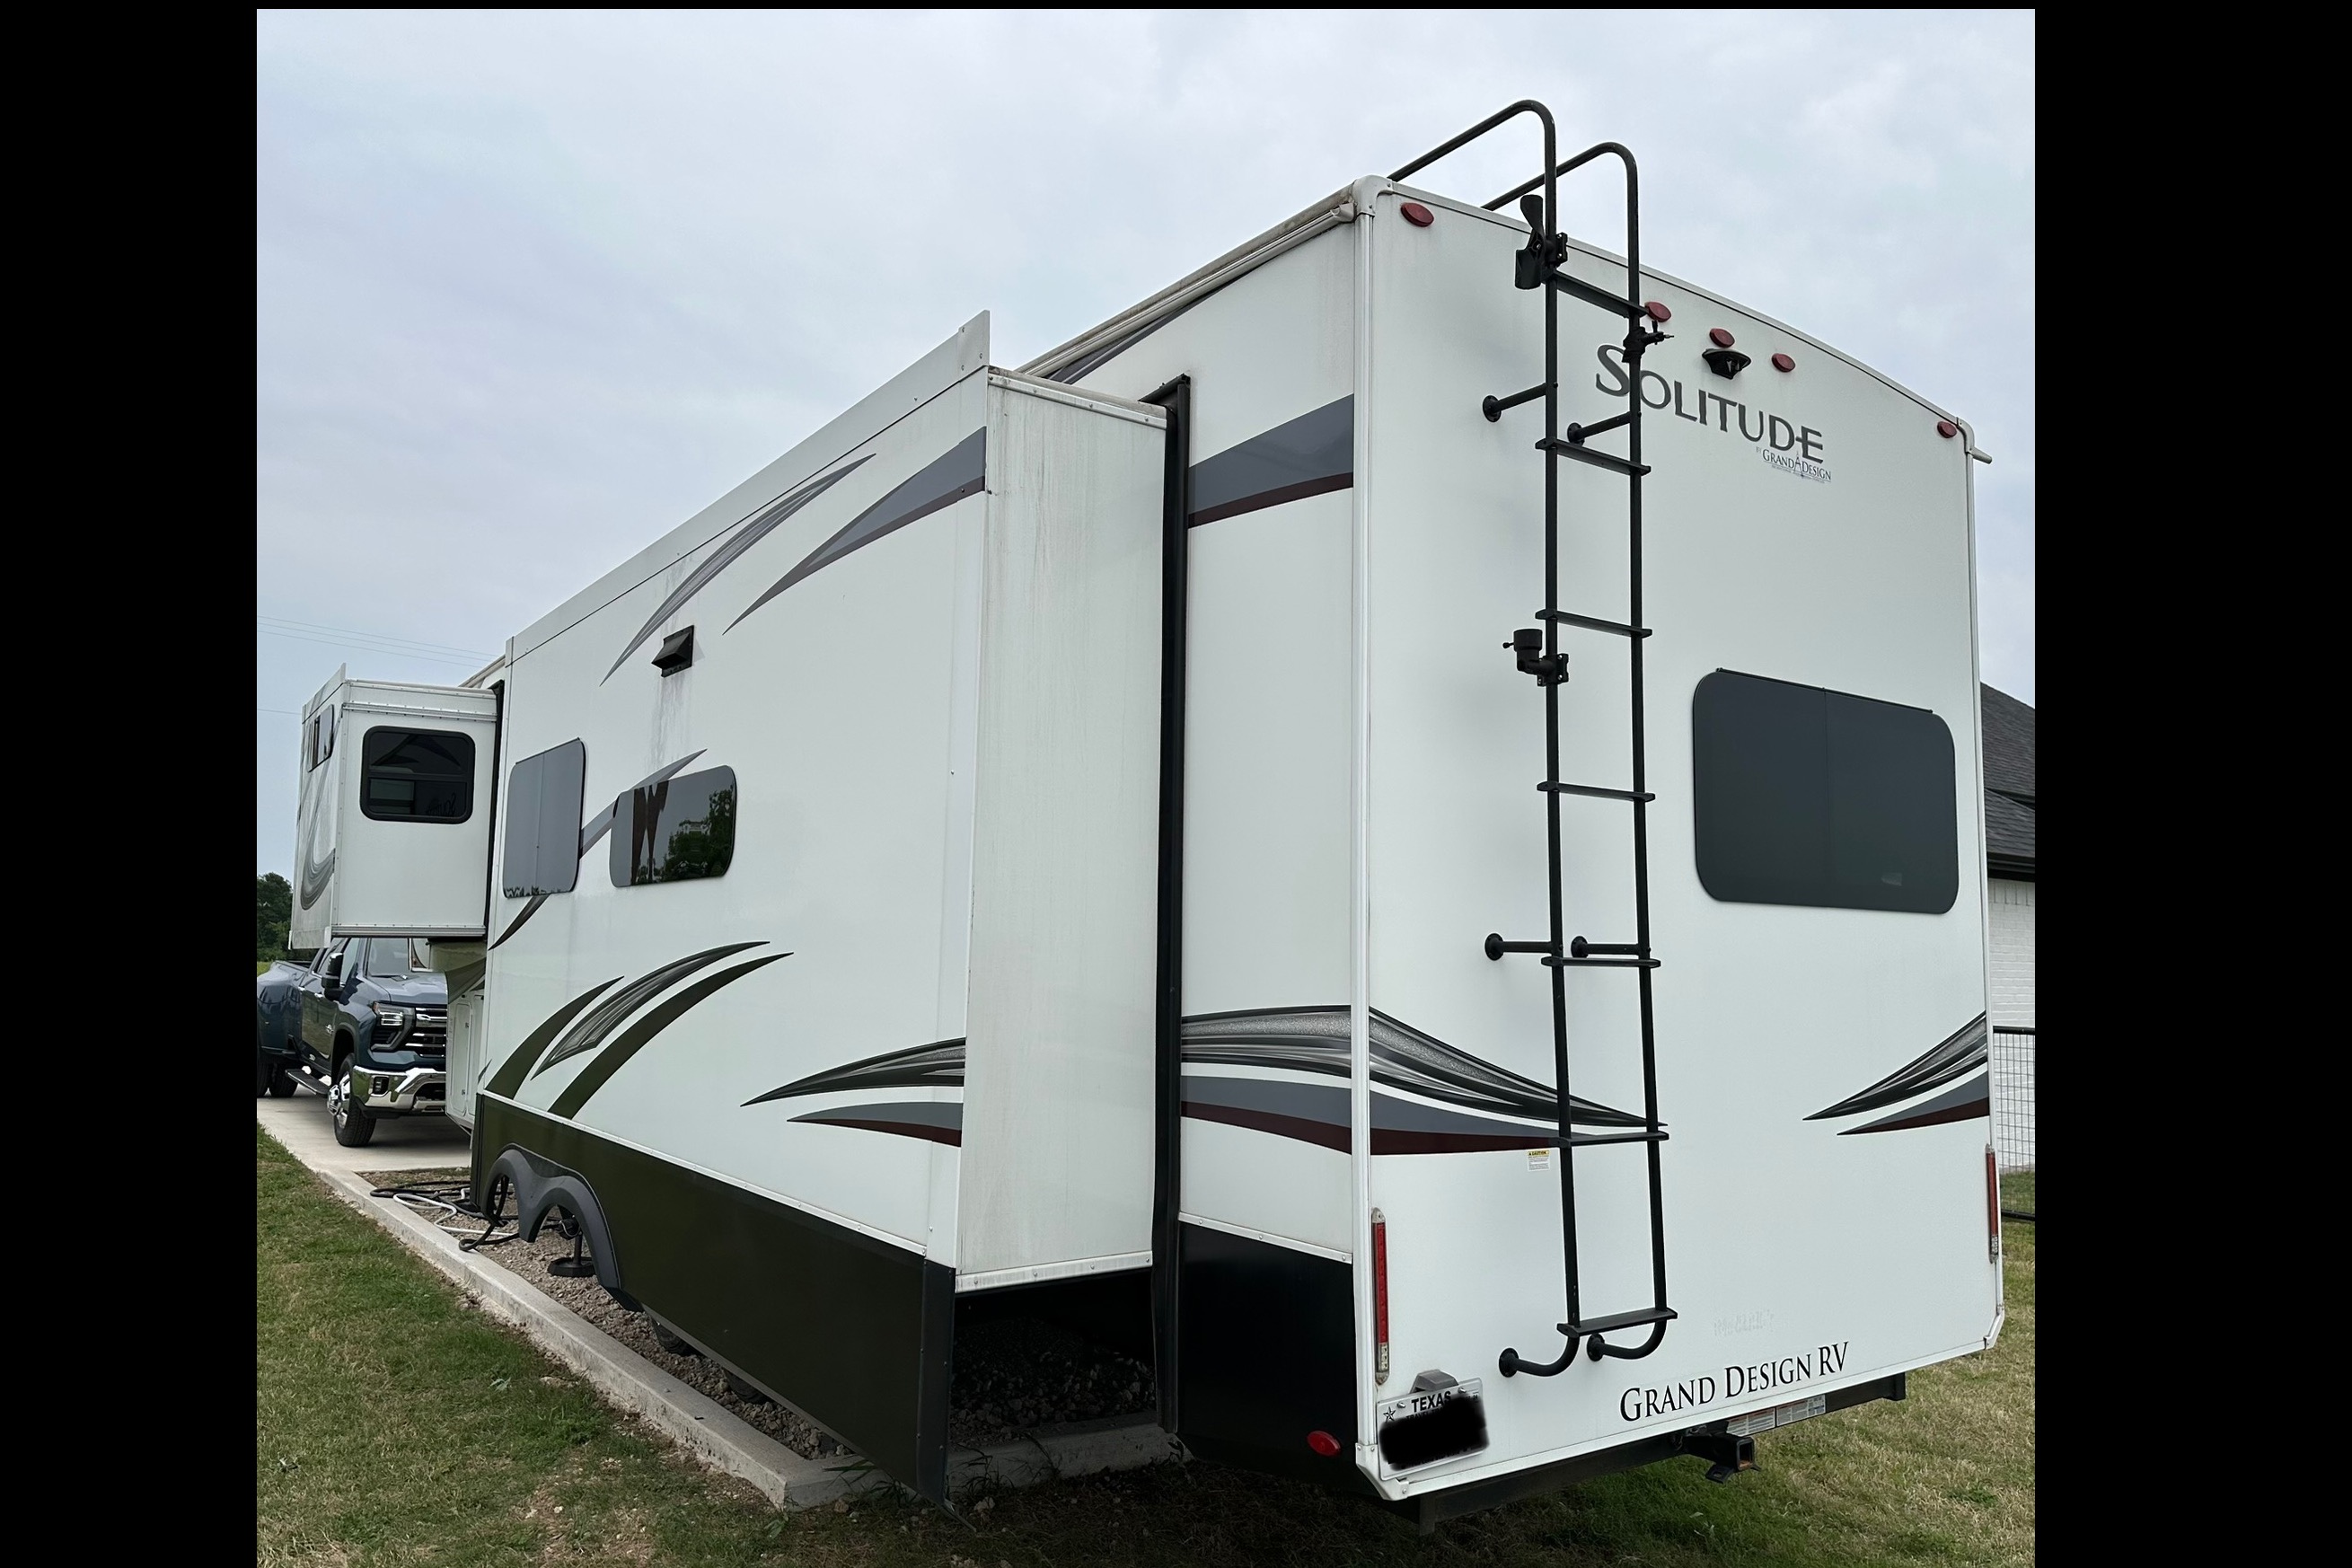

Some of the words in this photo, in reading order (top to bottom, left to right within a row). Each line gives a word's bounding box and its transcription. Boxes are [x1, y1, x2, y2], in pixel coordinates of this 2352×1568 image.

[1595, 344, 1824, 464] SOLITUDE
[1762, 448, 1794, 469] GRAND
[1801, 460, 1831, 480] DESIGN
[1411, 1390, 1451, 1413] TEXAS
[1619, 1376, 1716, 1422] GRAND
[1724, 1353, 1811, 1399] DESIGN
[1818, 1341, 1849, 1377] RV
